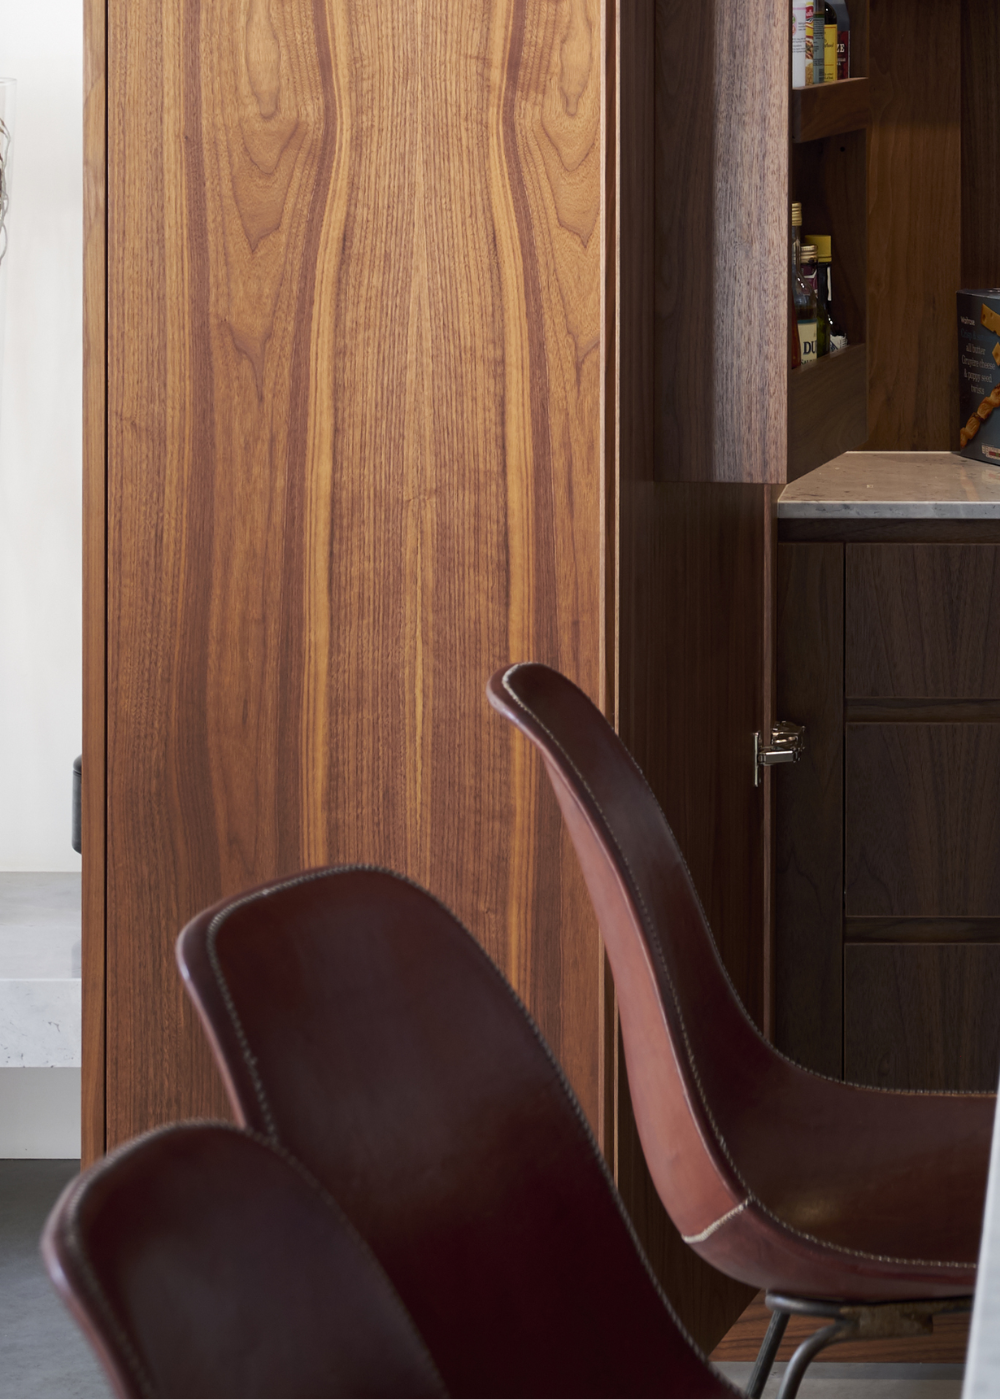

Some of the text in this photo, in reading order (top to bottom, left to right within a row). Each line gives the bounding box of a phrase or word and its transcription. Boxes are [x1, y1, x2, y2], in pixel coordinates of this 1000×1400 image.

[979, 357, 996, 371] cheese
[967, 370, 981, 383] poppy
[981, 373, 993, 383] seed
